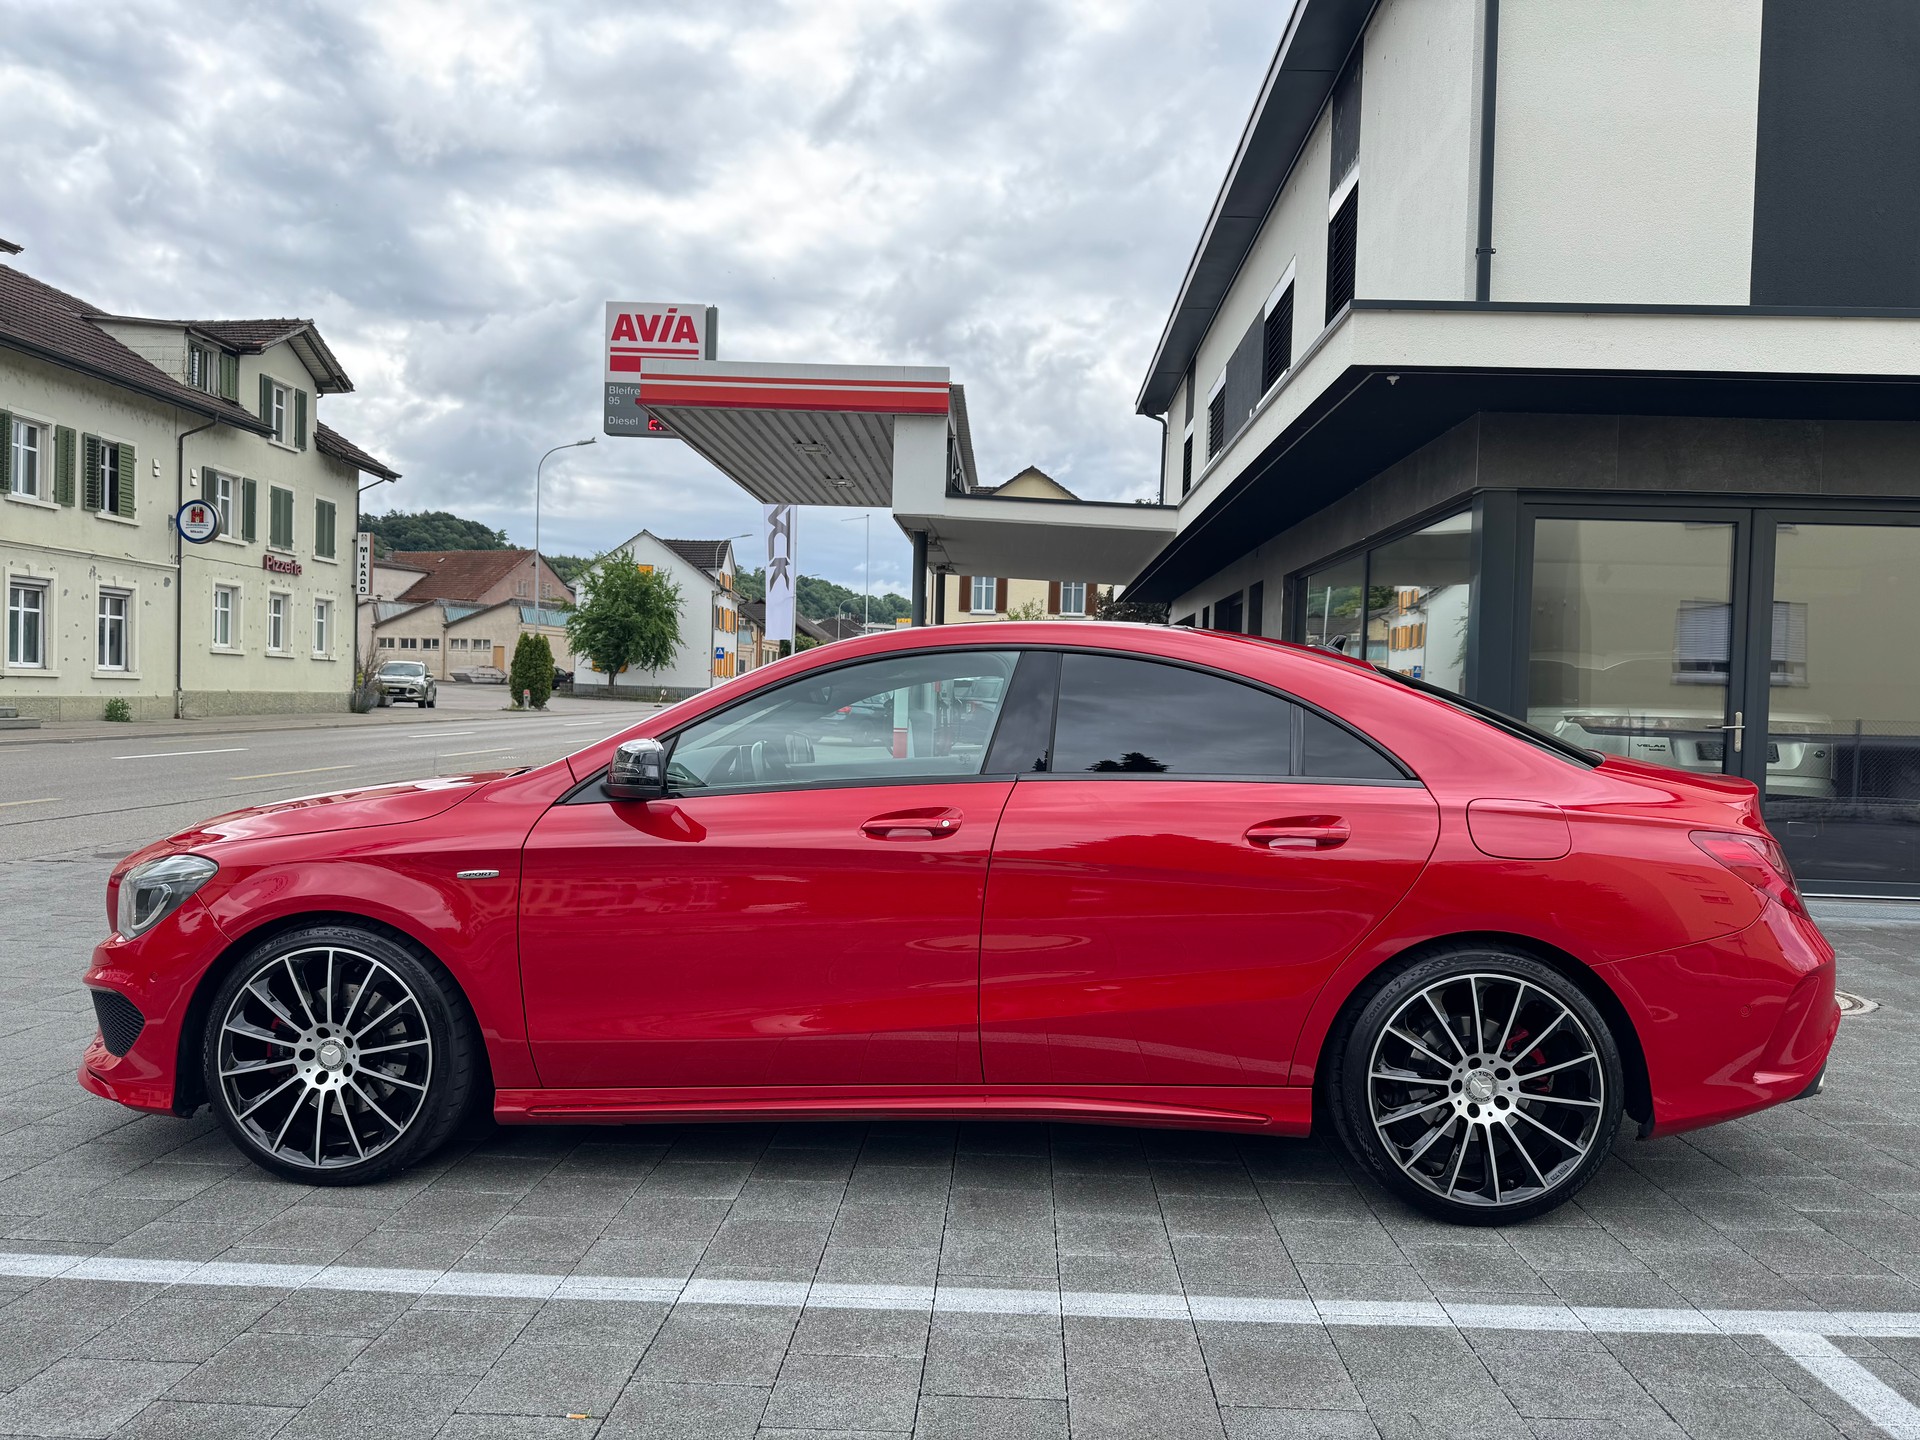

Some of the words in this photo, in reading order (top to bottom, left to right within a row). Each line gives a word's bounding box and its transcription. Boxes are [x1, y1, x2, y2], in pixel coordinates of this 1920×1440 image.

[611, 308, 699, 343] AVIA
[608, 386, 640, 395] Bleifre
[608, 397, 620, 405] 95
[608, 416, 638, 425] Diesel
[265, 555, 303, 576] Pizzeria
[359, 547, 368, 593] MIKADO
[298, 929, 312, 937] XL
[1364, 988, 1396, 1025] Contact
